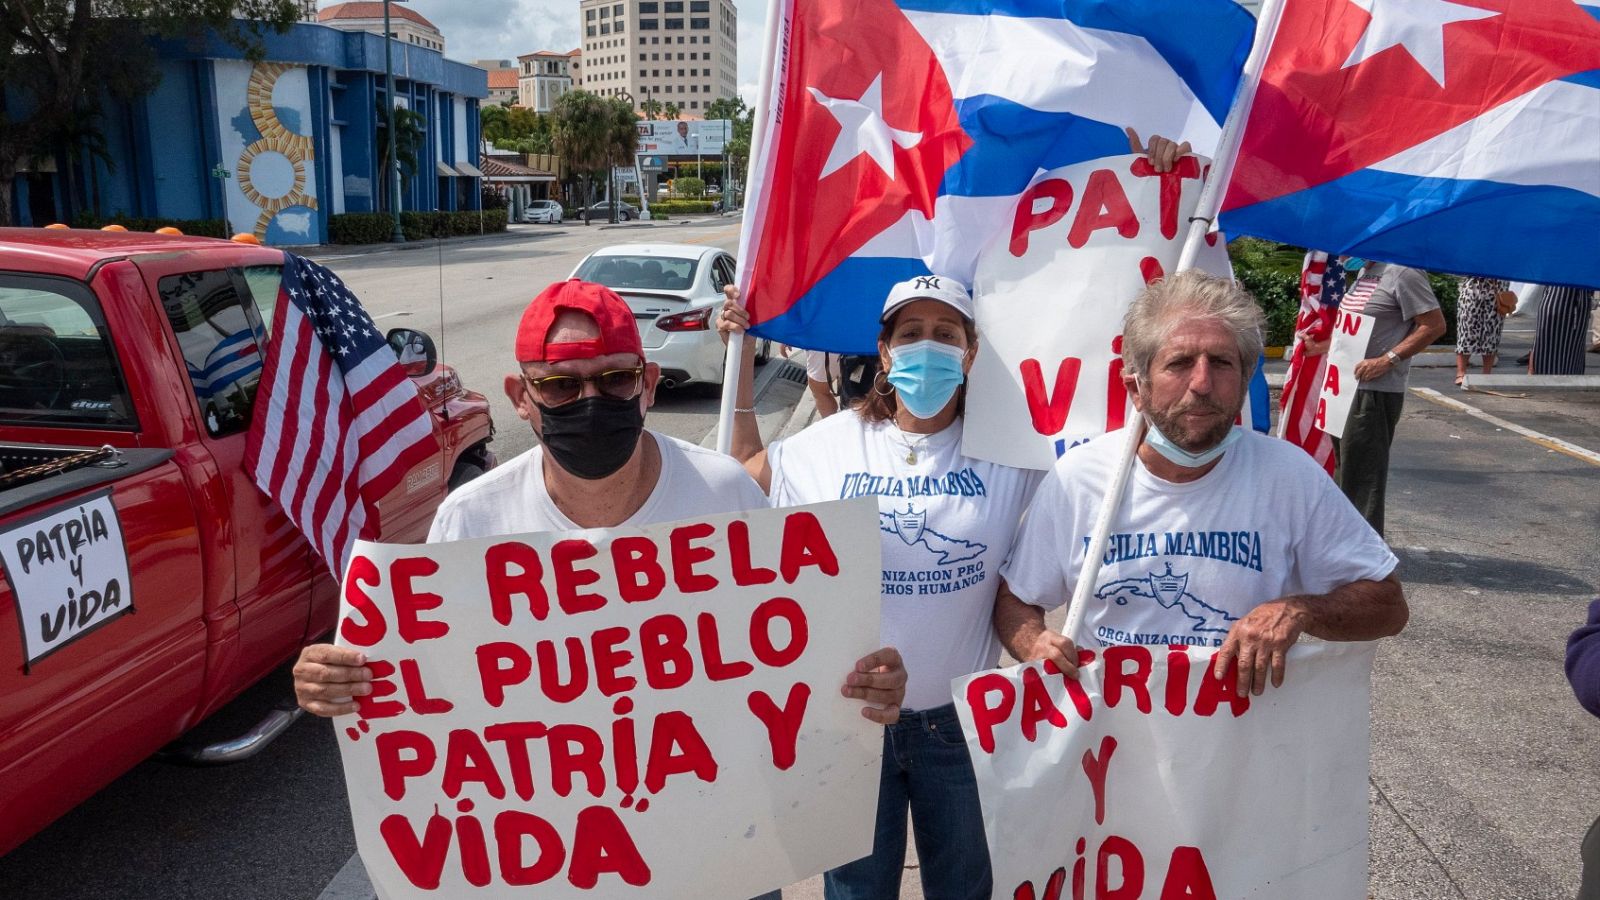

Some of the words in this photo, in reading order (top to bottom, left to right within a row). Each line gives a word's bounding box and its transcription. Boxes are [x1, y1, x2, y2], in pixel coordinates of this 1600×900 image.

[841, 472, 904, 499] VIGILIA
[906, 467, 987, 498] MAMBISA
[957, 560, 984, 578] PRO
[1164, 531, 1263, 572] MAMBISA
[340, 555, 450, 647] SE
[485, 511, 840, 626] REBELA
[918, 571, 986, 595] HUMANOS
[1098, 626, 1208, 648] ORGANIZACION
[353, 658, 454, 719] EL
[475, 597, 809, 708] PUEBLO
[747, 681, 811, 770] Y
[1082, 735, 1118, 826] Y
